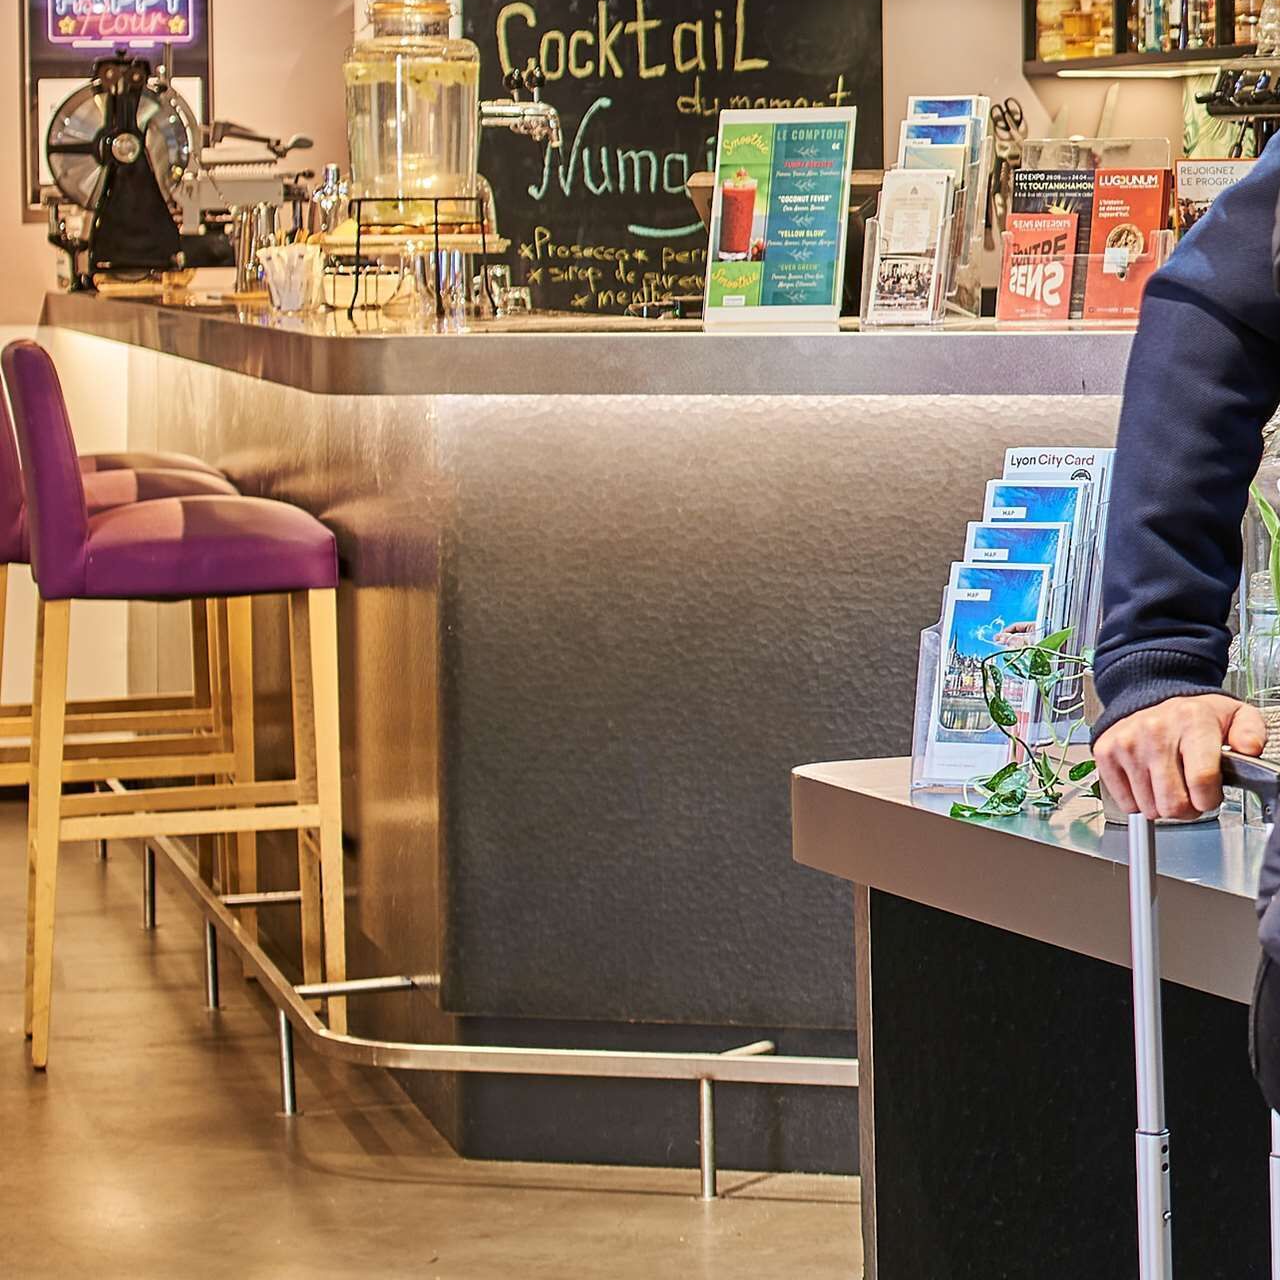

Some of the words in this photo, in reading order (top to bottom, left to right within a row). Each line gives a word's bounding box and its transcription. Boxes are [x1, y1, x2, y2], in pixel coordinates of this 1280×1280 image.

[75, 0, 168, 36] Hour
[676, 75, 718, 117] du
[777, 130, 787, 141] LE
[791, 128, 845, 141] COMPTOIR
[722, 133, 769, 157] Smoothie
[1180, 166, 1235, 175] REJOIGNEZ
[1028, 173, 1046, 182] EXPO
[1181, 177, 1194, 186] LE
[1028, 182, 1094, 190] TOUTANKHAMON
[711, 267, 759, 289] Smoothie
[1010, 454, 1036, 468] Lyon
[1038, 454, 1063, 468] City
[1064, 454, 1095, 466] Card
